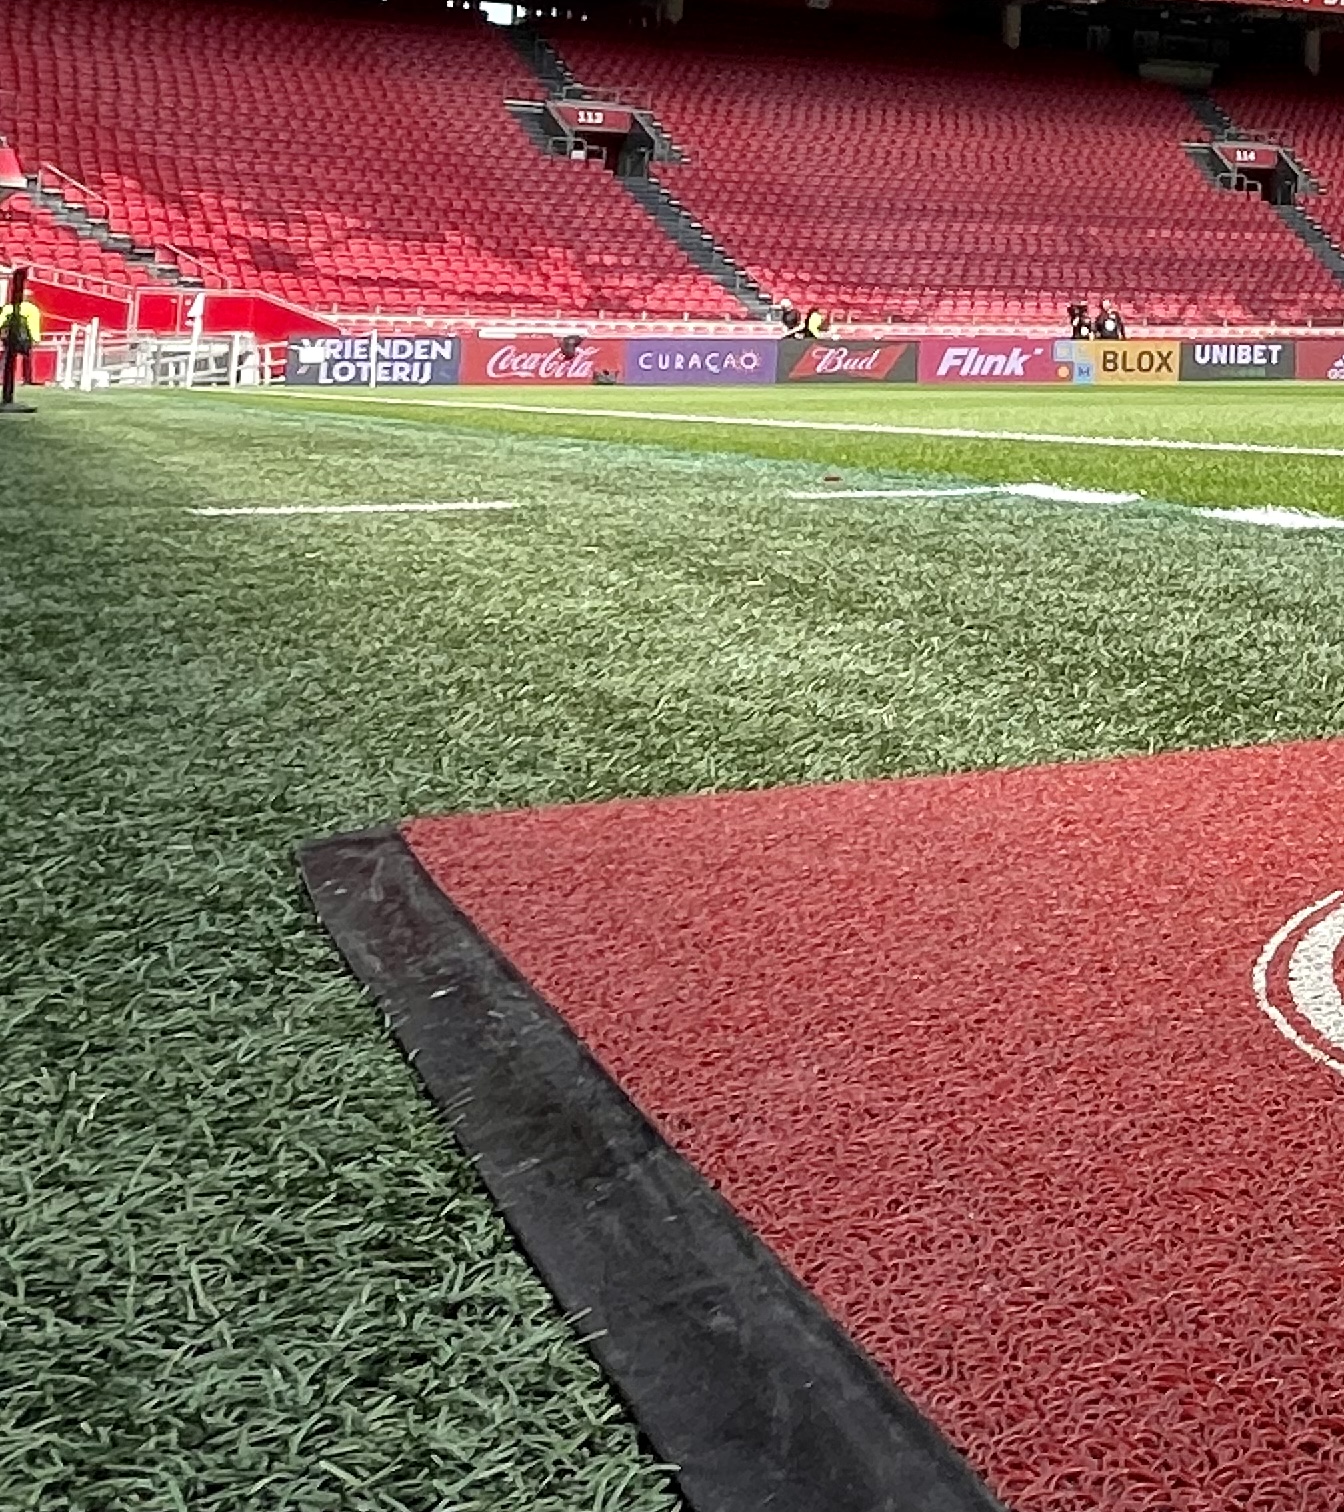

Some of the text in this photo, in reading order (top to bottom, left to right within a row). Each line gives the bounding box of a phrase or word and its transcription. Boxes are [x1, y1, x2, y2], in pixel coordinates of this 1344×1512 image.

[1236, 150, 1256, 161] 114
[638, 350, 760, 374] CURAÇAO
[811, 346, 883, 374] Bud
[936, 346, 1034, 376] Flink
[1102, 350, 1174, 373] BLOX
[1193, 344, 1282, 365] UNIBET
[319, 361, 432, 384] LOTERIJ
